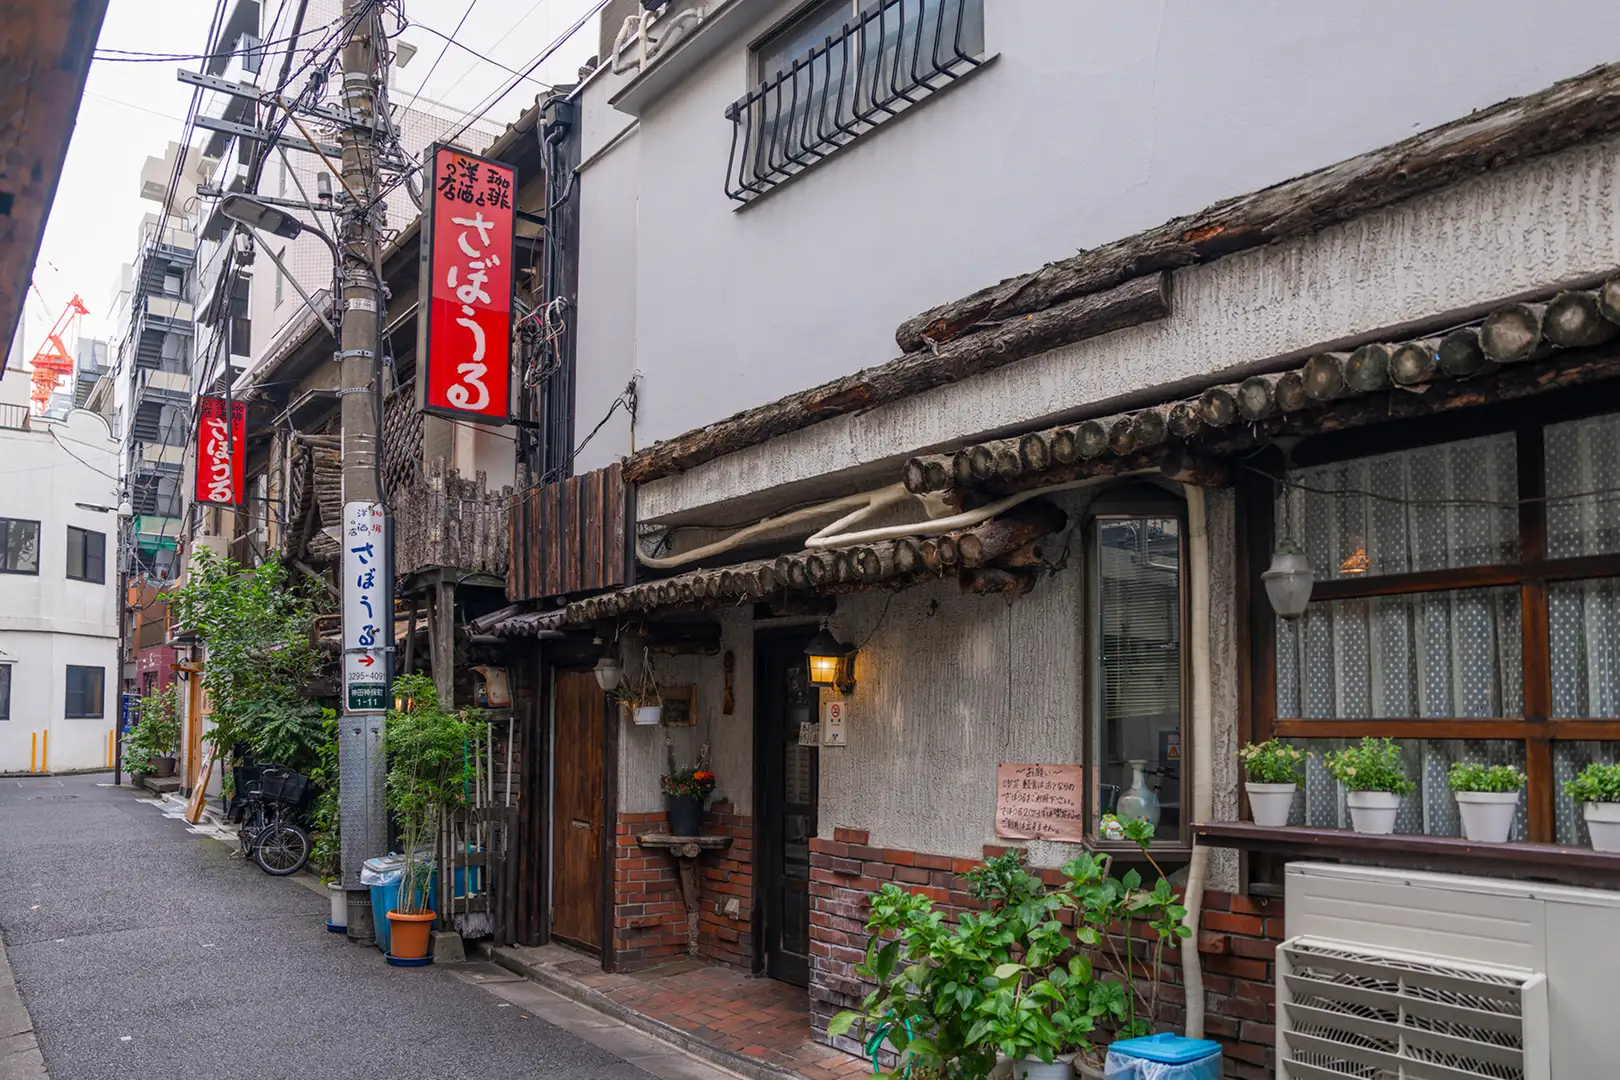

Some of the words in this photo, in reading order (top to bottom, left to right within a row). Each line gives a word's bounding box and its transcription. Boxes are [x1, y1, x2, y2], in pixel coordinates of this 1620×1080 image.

[437, 163, 456, 201] の店
[457, 158, 480, 205] 洋酒
[487, 168, 511, 210] 珈琲
[446, 211, 501, 411] さぼうる
[206, 417, 238, 503] さぼうる
[351, 542, 376, 646] さぼうる
[348, 671, 386, 681] 3295-4091
[351, 688, 383, 698] 神田神保町
[357, 698, 378, 706] 1-11
